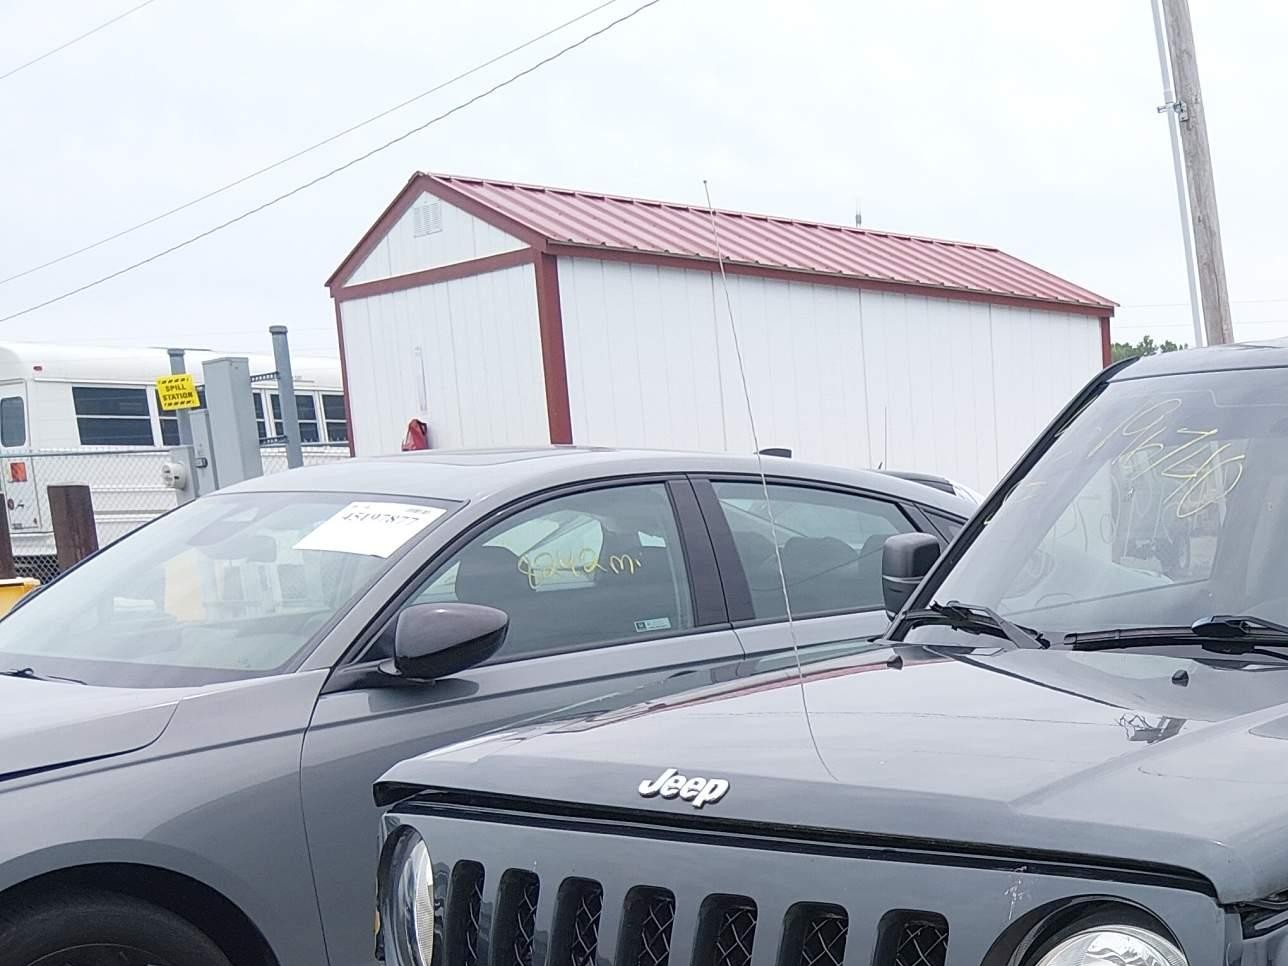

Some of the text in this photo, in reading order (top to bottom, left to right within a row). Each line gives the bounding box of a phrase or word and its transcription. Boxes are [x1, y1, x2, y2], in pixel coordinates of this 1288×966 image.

[165, 383, 187, 392] SPILL
[162, 392, 194, 401] STATION
[638, 767, 731, 810] Jeep
